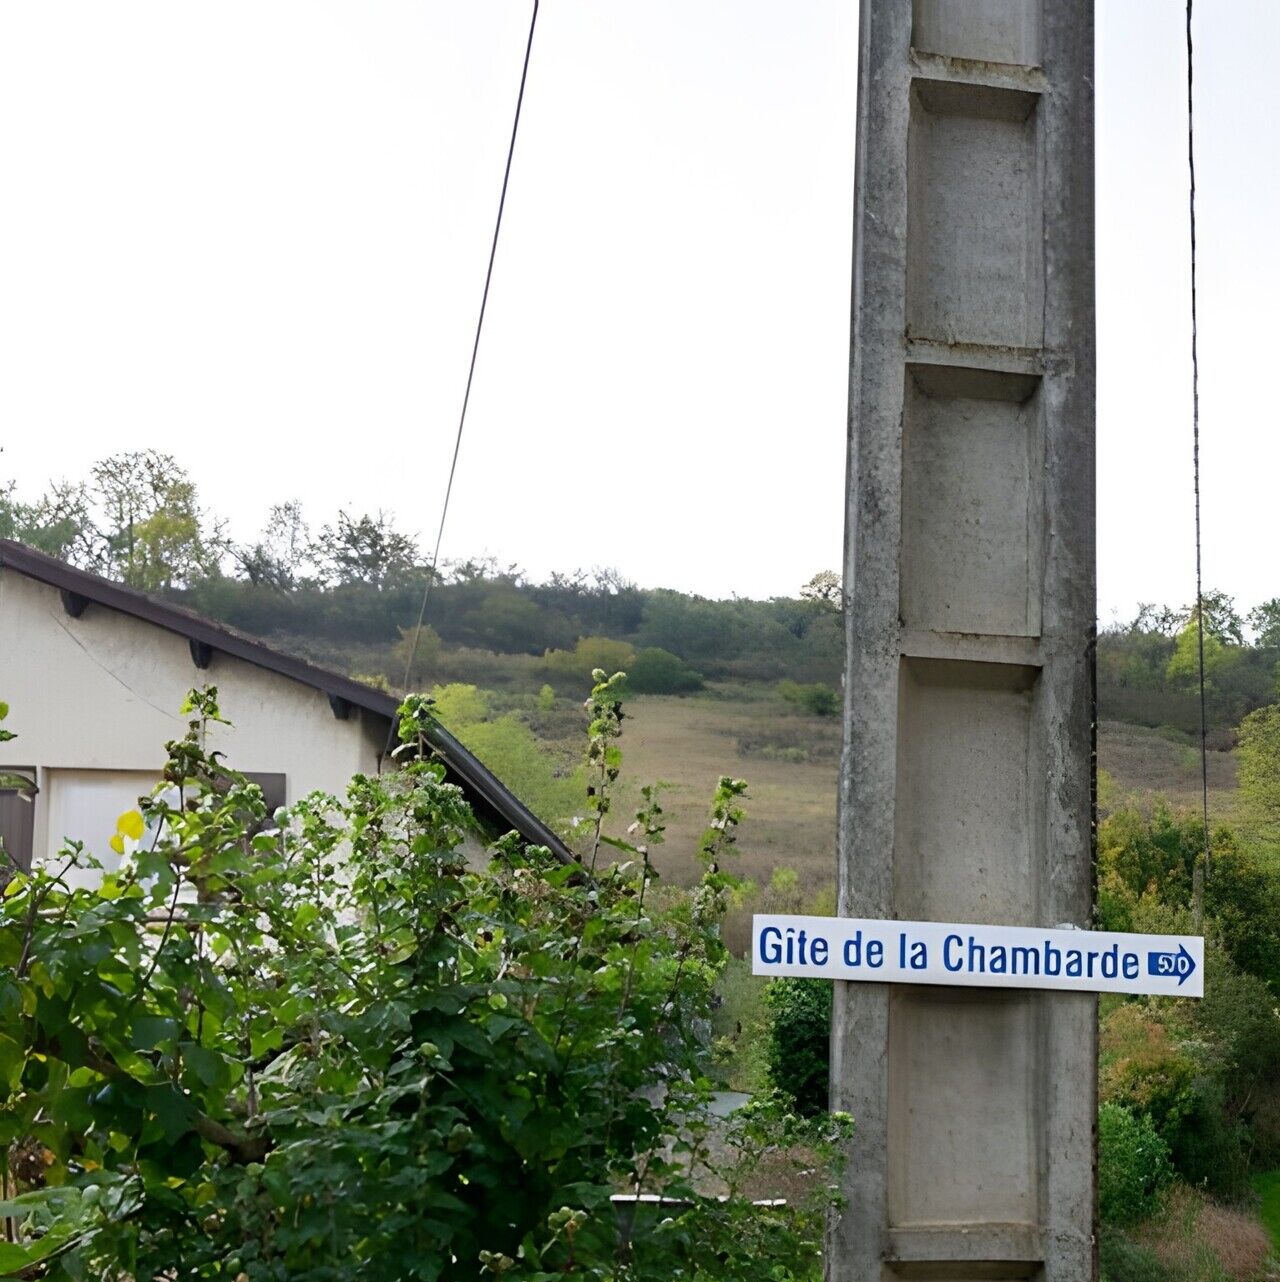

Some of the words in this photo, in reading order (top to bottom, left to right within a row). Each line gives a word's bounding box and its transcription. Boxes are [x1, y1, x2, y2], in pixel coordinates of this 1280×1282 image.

[759, 926, 829, 966] Gîte
[843, 929, 884, 969] de
[898, 932, 928, 971] la
[943, 933, 1139, 981] Chambarde
